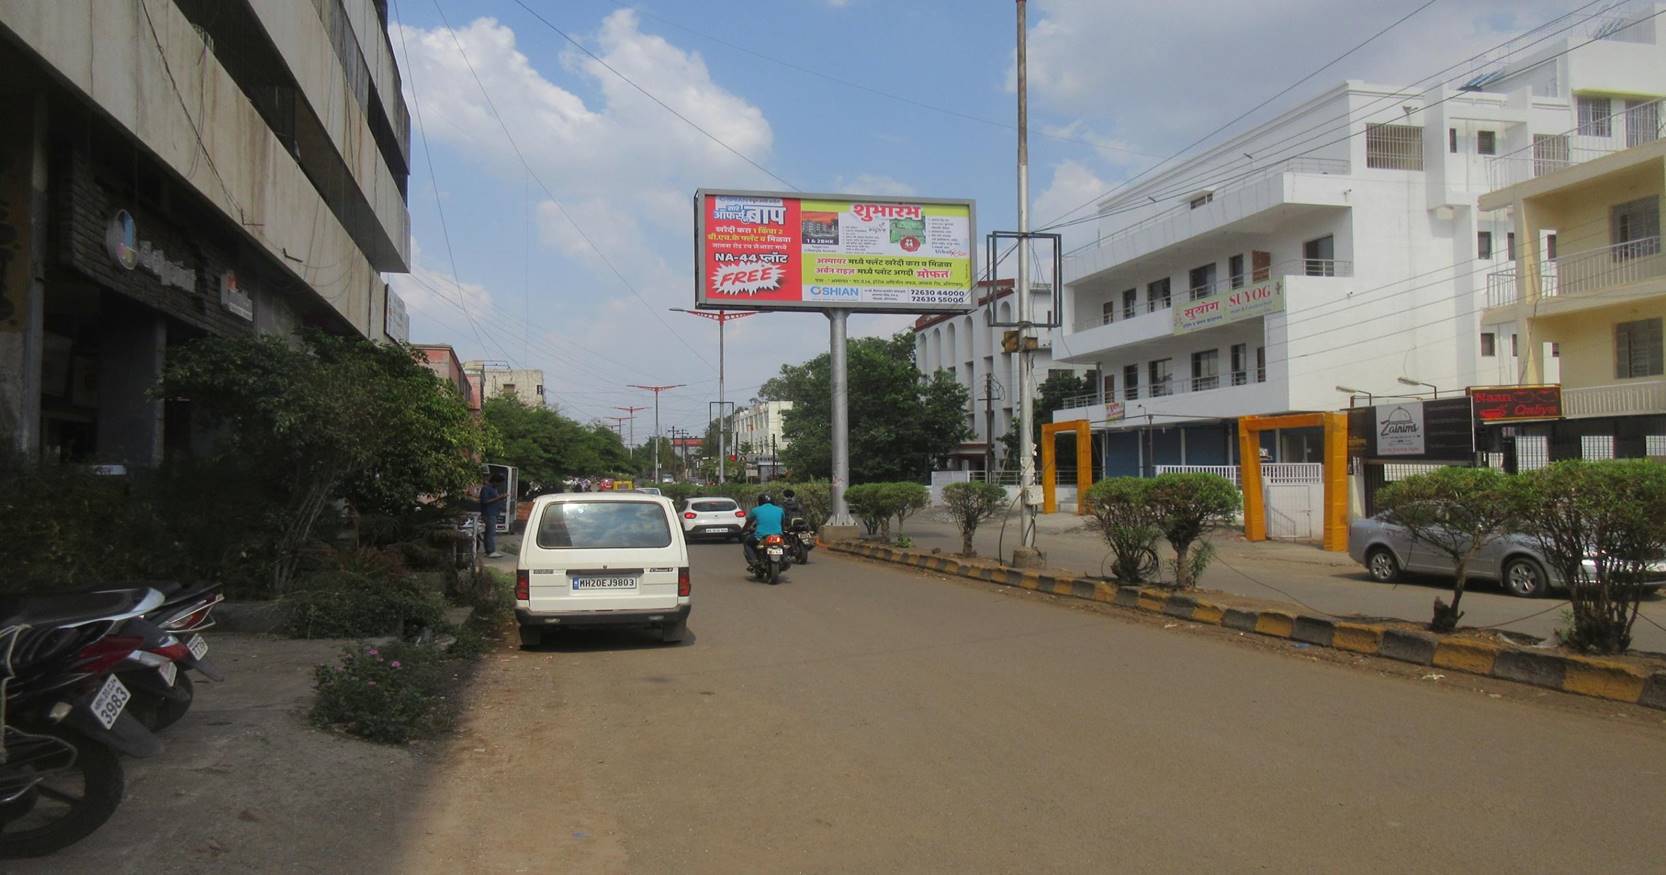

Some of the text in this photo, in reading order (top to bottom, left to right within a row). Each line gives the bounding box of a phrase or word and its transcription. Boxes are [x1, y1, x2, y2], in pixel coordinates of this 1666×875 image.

[853, 203, 922, 222] शुभारंभ
[715, 252, 788, 263] NA-44 प्लॉट
[720, 267, 773, 287] FREE
[1229, 285, 1271, 306] SUYOG
[1183, 301, 1219, 320] सुयोग
[579, 578, 635, 588] MH20EJ9803
[101, 687, 128, 725] 3983
